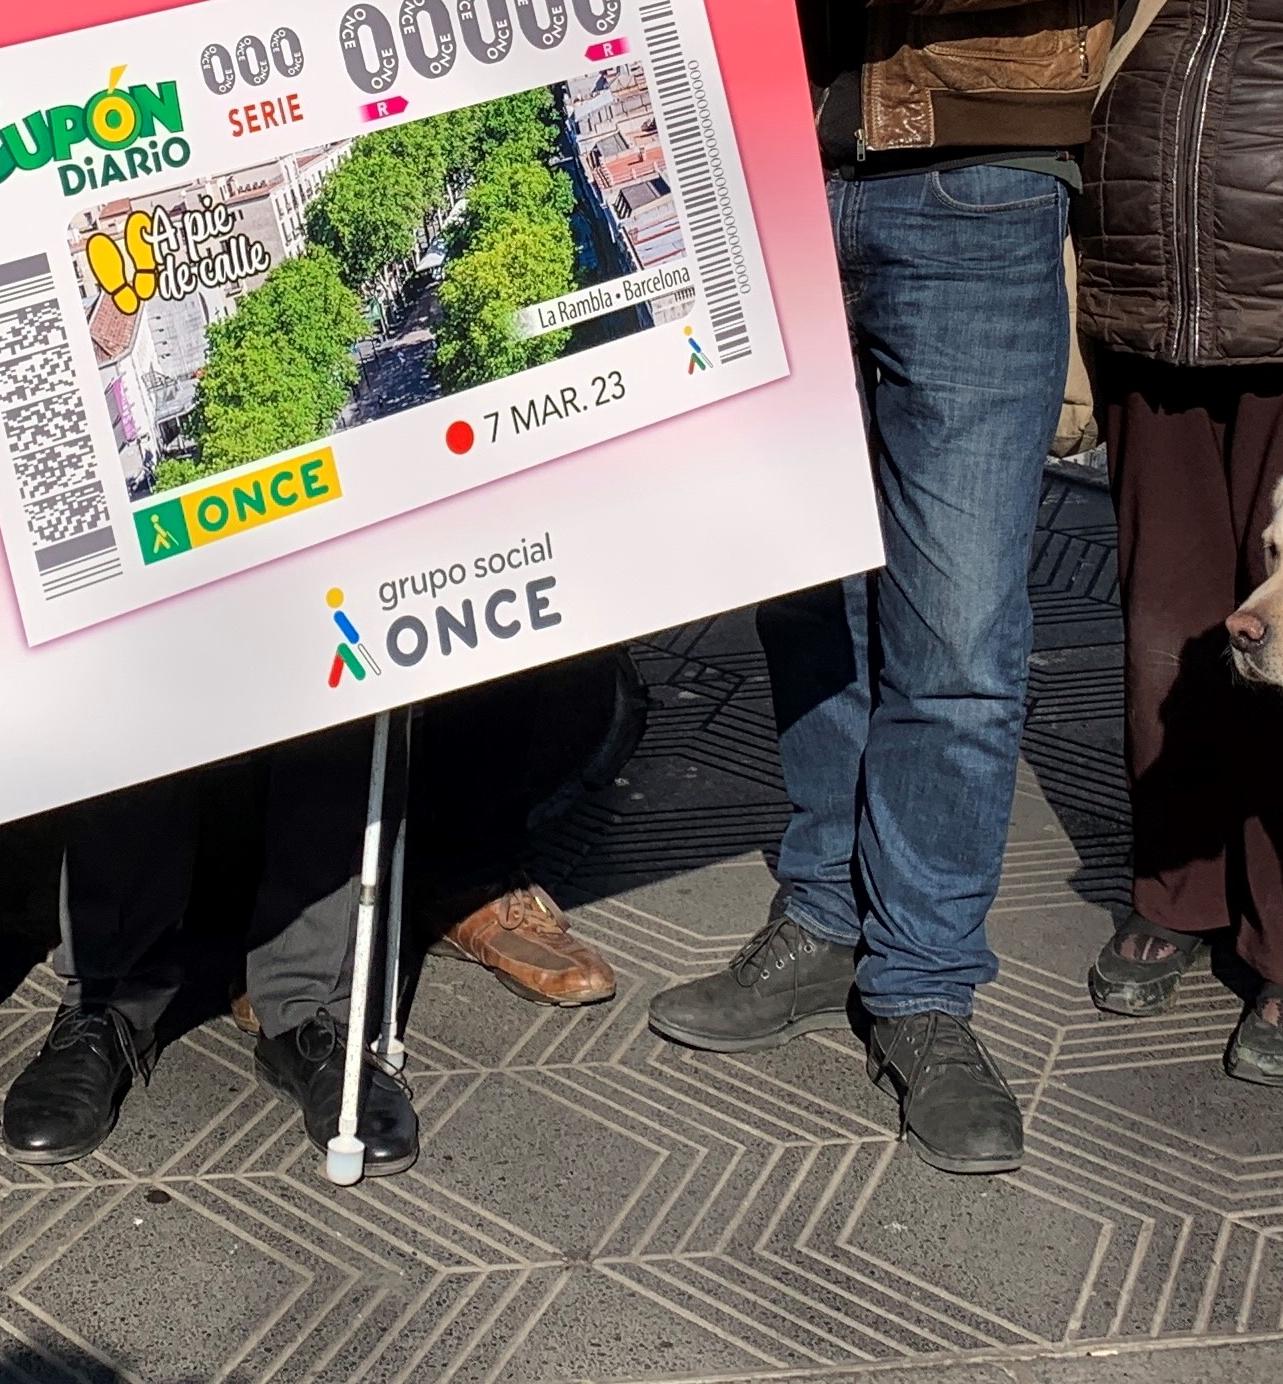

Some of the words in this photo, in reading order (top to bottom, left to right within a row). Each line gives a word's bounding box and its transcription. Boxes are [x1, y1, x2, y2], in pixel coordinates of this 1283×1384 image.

[271, 29, 286, 53] ONCE
[342, 8, 366, 49] ONCE
[486, 19, 510, 59] ONCE
[542, 5, 565, 45] ONCE
[201, 27, 305, 95] 000
[202, 46, 217, 69] ONCE
[237, 37, 251, 62] ONCE
[288, 51, 302, 76] ONCE
[371, 48, 395, 89] ONCE
[430, 33, 453, 74] ONCE
[603, 43, 614, 57] R
[219, 69, 234, 92] ONCE
[253, 59, 268, 84] ONCE
[228, 93, 305, 138] SERIE
[377, 102, 389, 117] R
[143, 205, 180, 265] A
[183, 195, 238, 264] pie
[159, 253, 198, 301] de
[198, 233, 272, 288] calle
[538, 307, 558, 329] La
[557, 288, 613, 322] Rambla
[622, 266, 692, 302] Barcelona
[484, 411, 501, 444] 7
[510, 386, 589, 435] MAR.
[591, 370, 627, 407] 23
[196, 458, 330, 533] ONCE
[378, 563, 467, 612] grupo
[473, 532, 554, 579] social
[385, 575, 563, 668] ONCE
